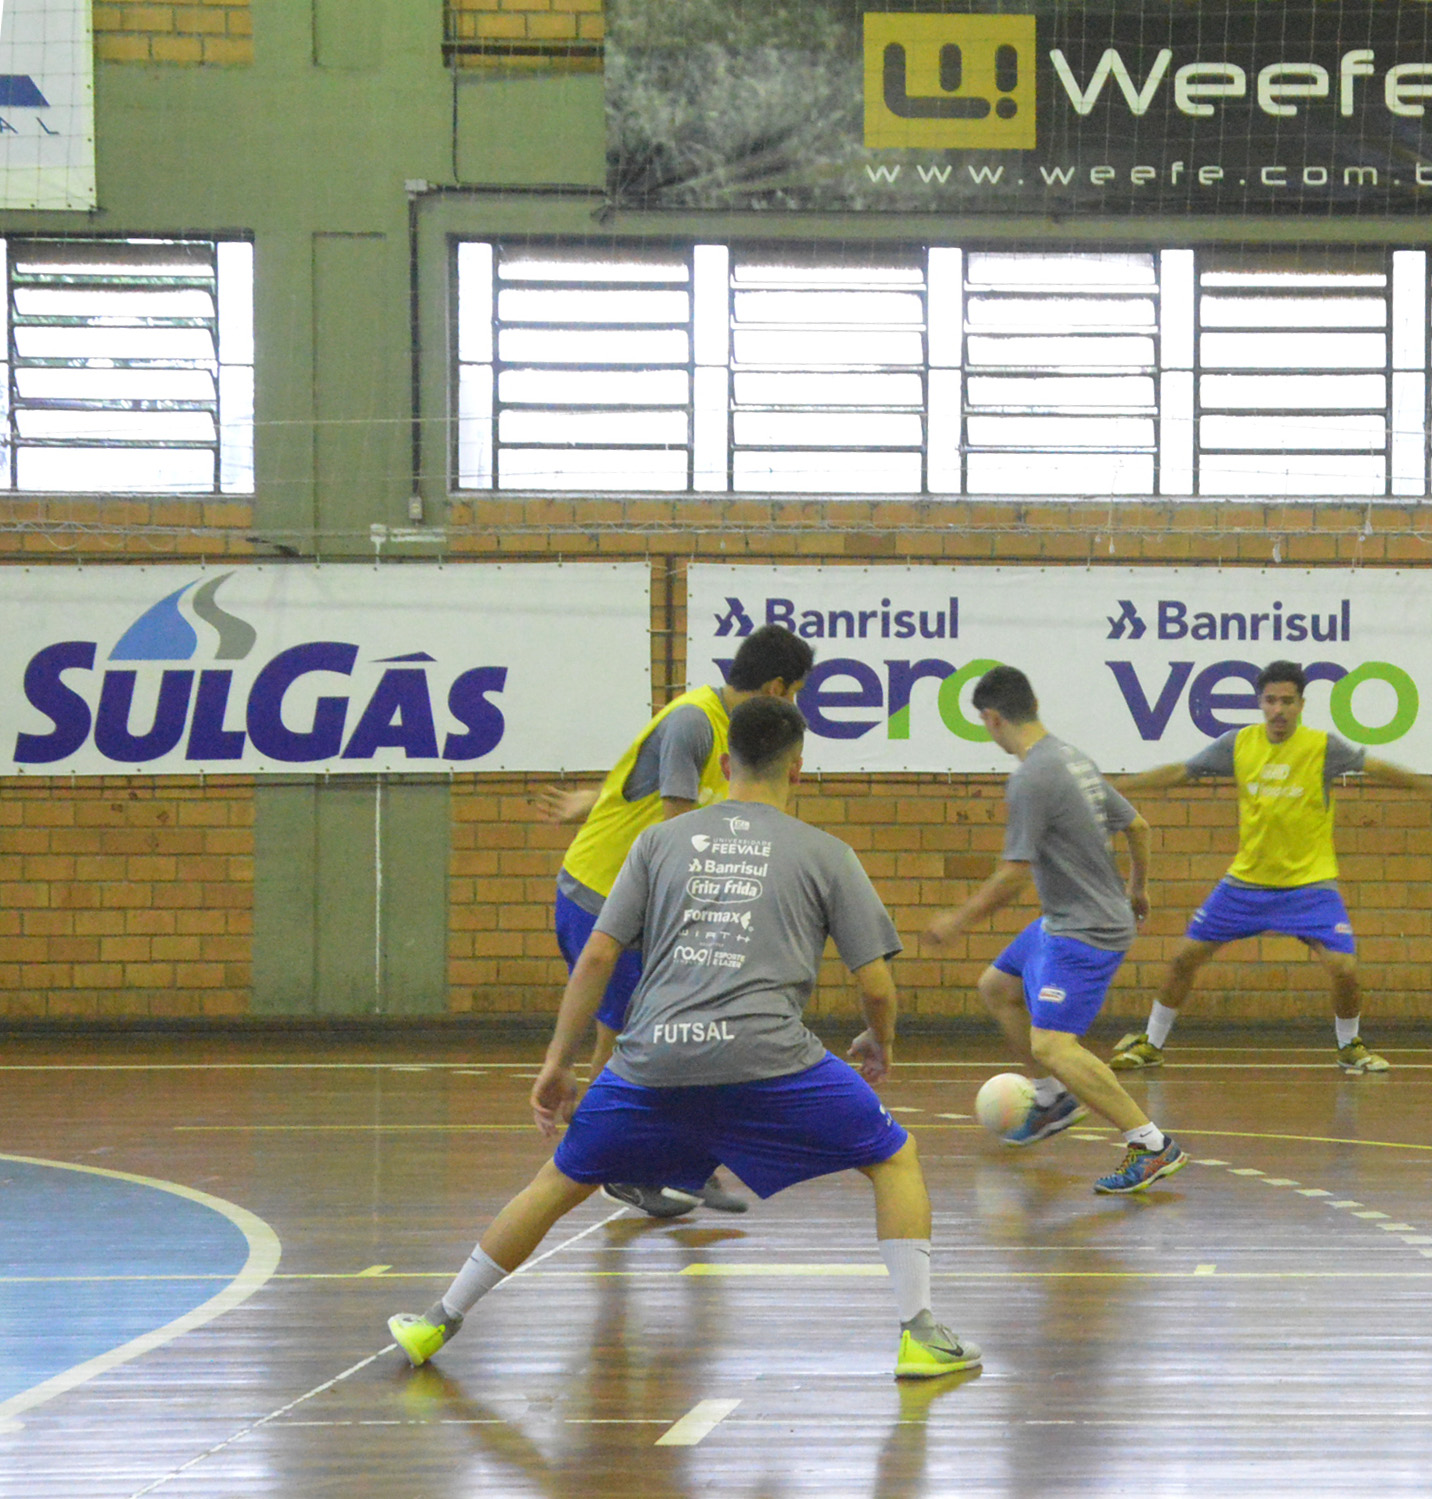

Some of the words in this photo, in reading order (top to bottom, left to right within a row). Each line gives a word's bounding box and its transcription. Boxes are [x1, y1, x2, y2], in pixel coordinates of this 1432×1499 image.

[765, 596, 959, 638] Banrisul
[1157, 599, 1351, 641] Banrisul
[711, 843, 771, 857] FEEVALE
[704, 860, 768, 877] Banrisul
[683, 909, 740, 923] Formax
[653, 1021, 734, 1044] FUTSAL
